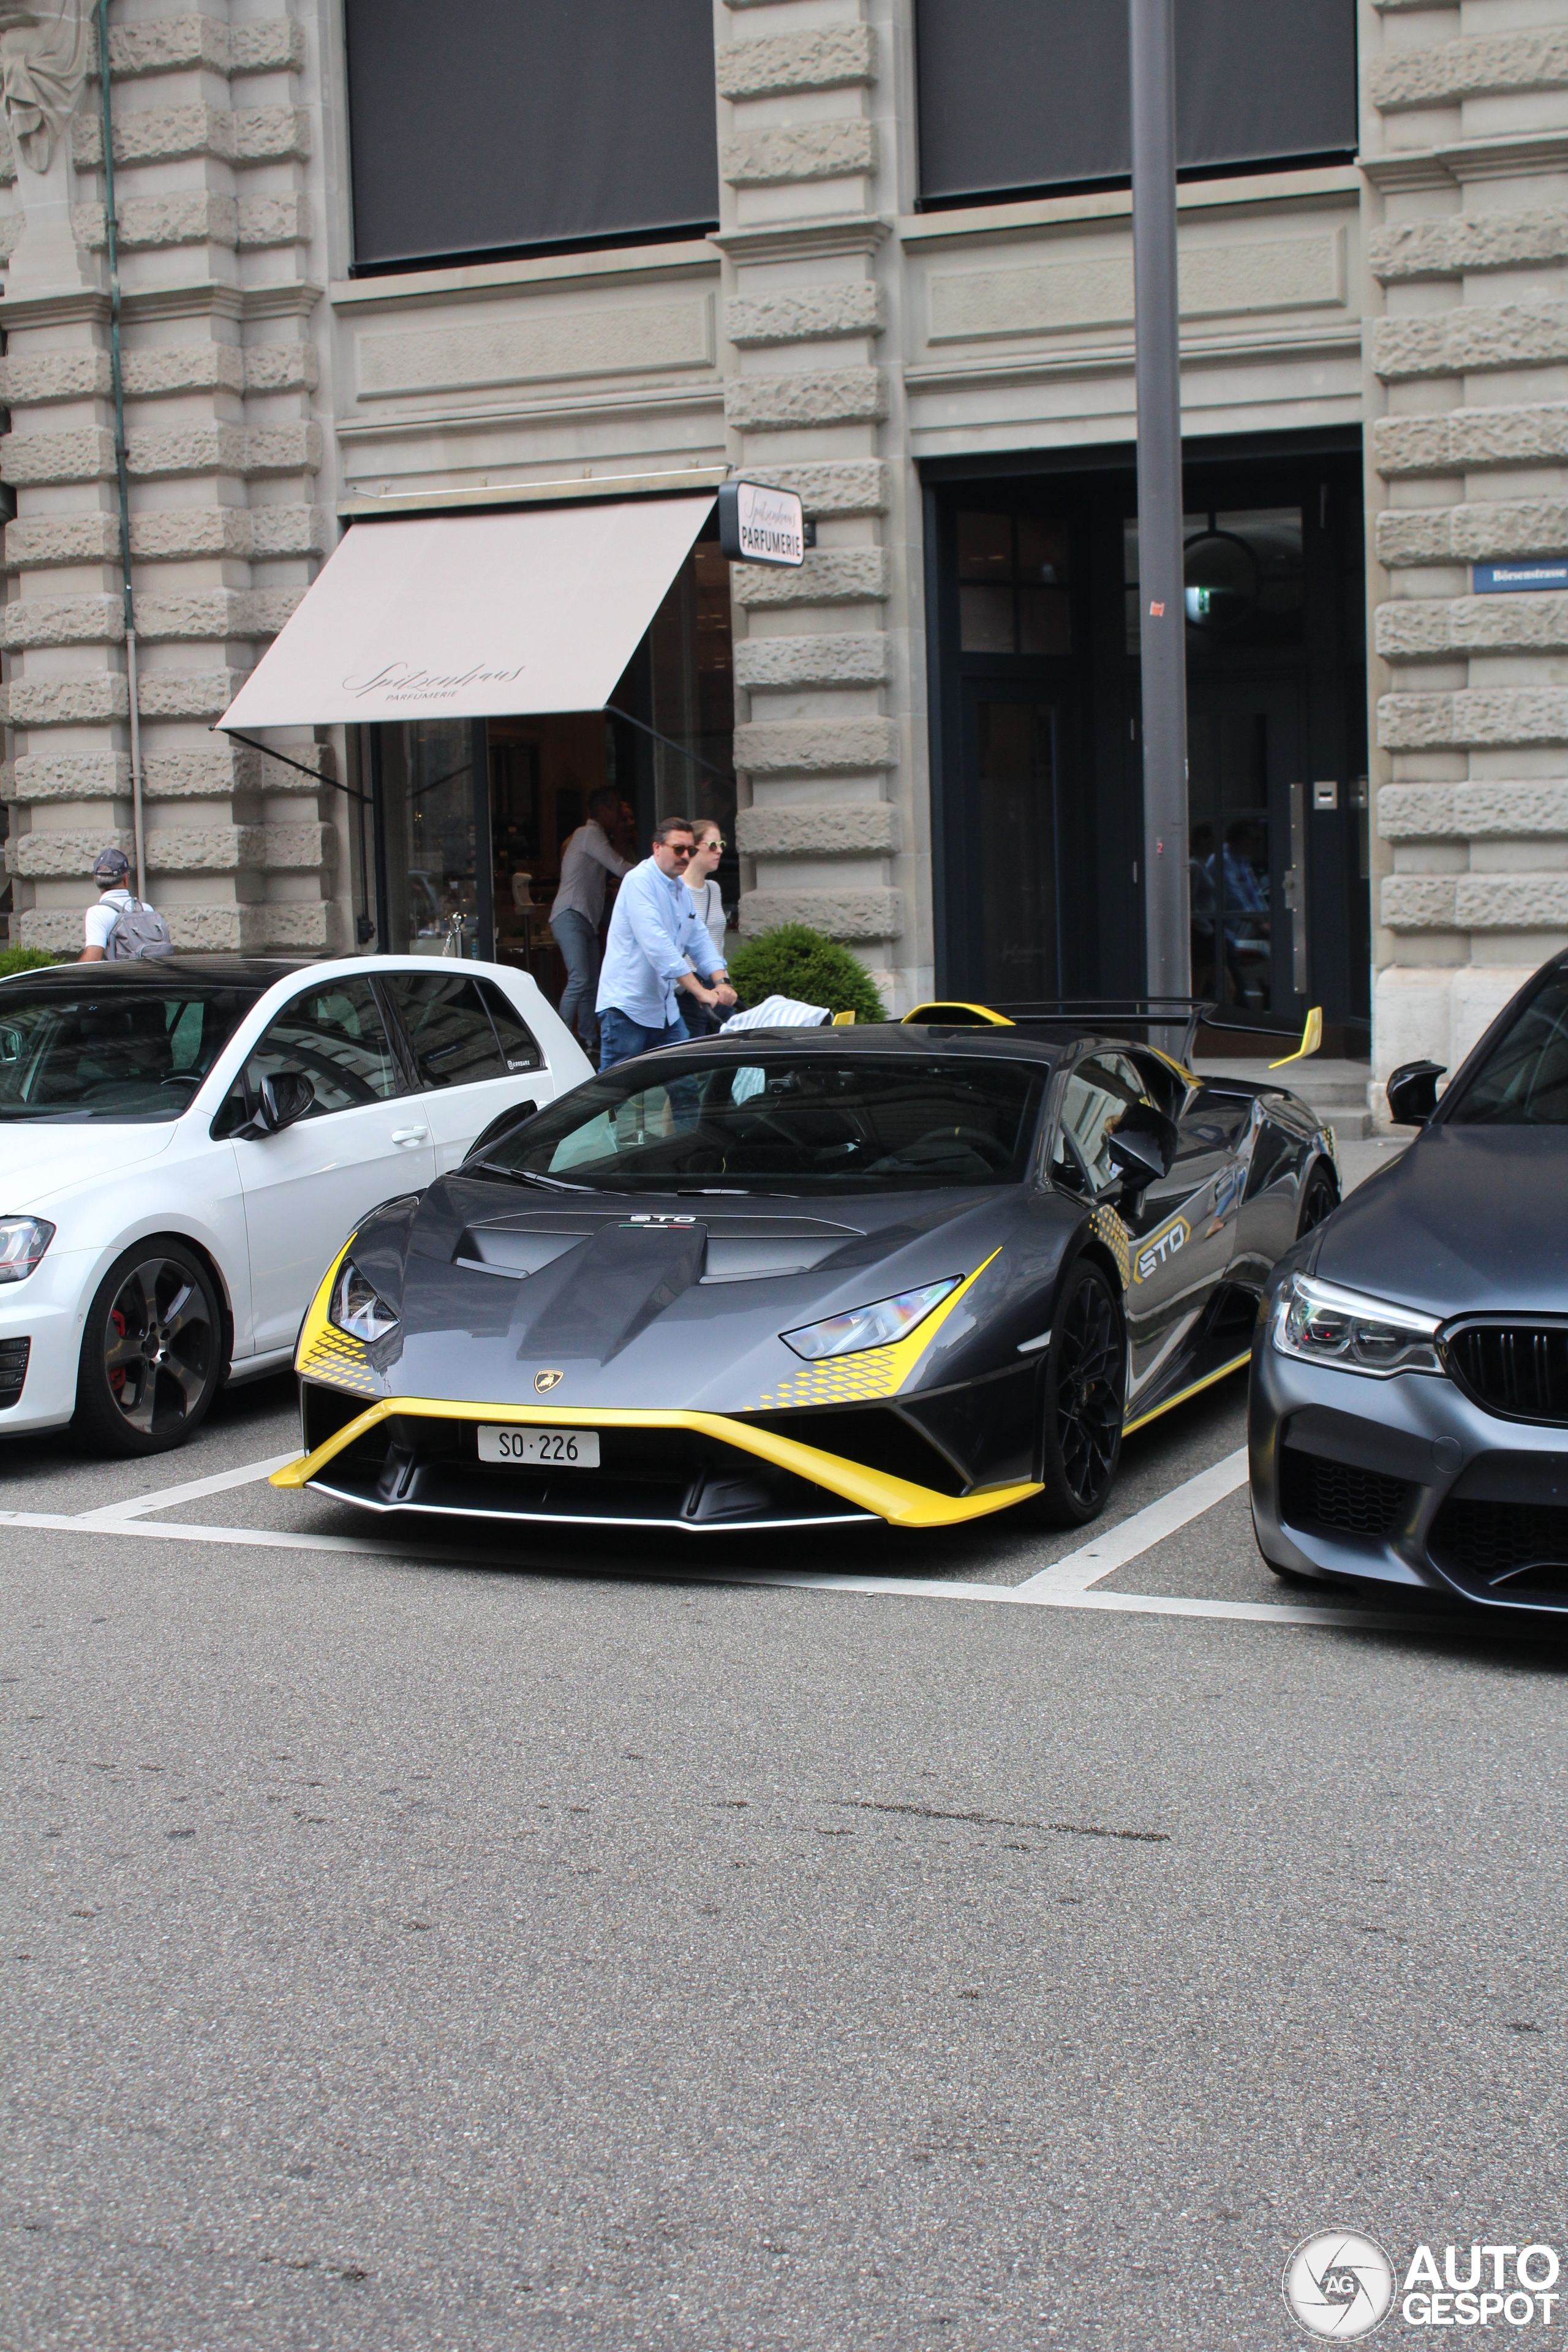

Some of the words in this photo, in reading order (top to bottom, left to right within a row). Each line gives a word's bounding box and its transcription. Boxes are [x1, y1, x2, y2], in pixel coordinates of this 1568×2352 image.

[741, 526, 801, 557] PARFUMERIE
[342, 662, 526, 698] Spitzenhaus
[385, 690, 458, 701] PARFUMERIE
[1139, 1224, 1185, 1278] STO
